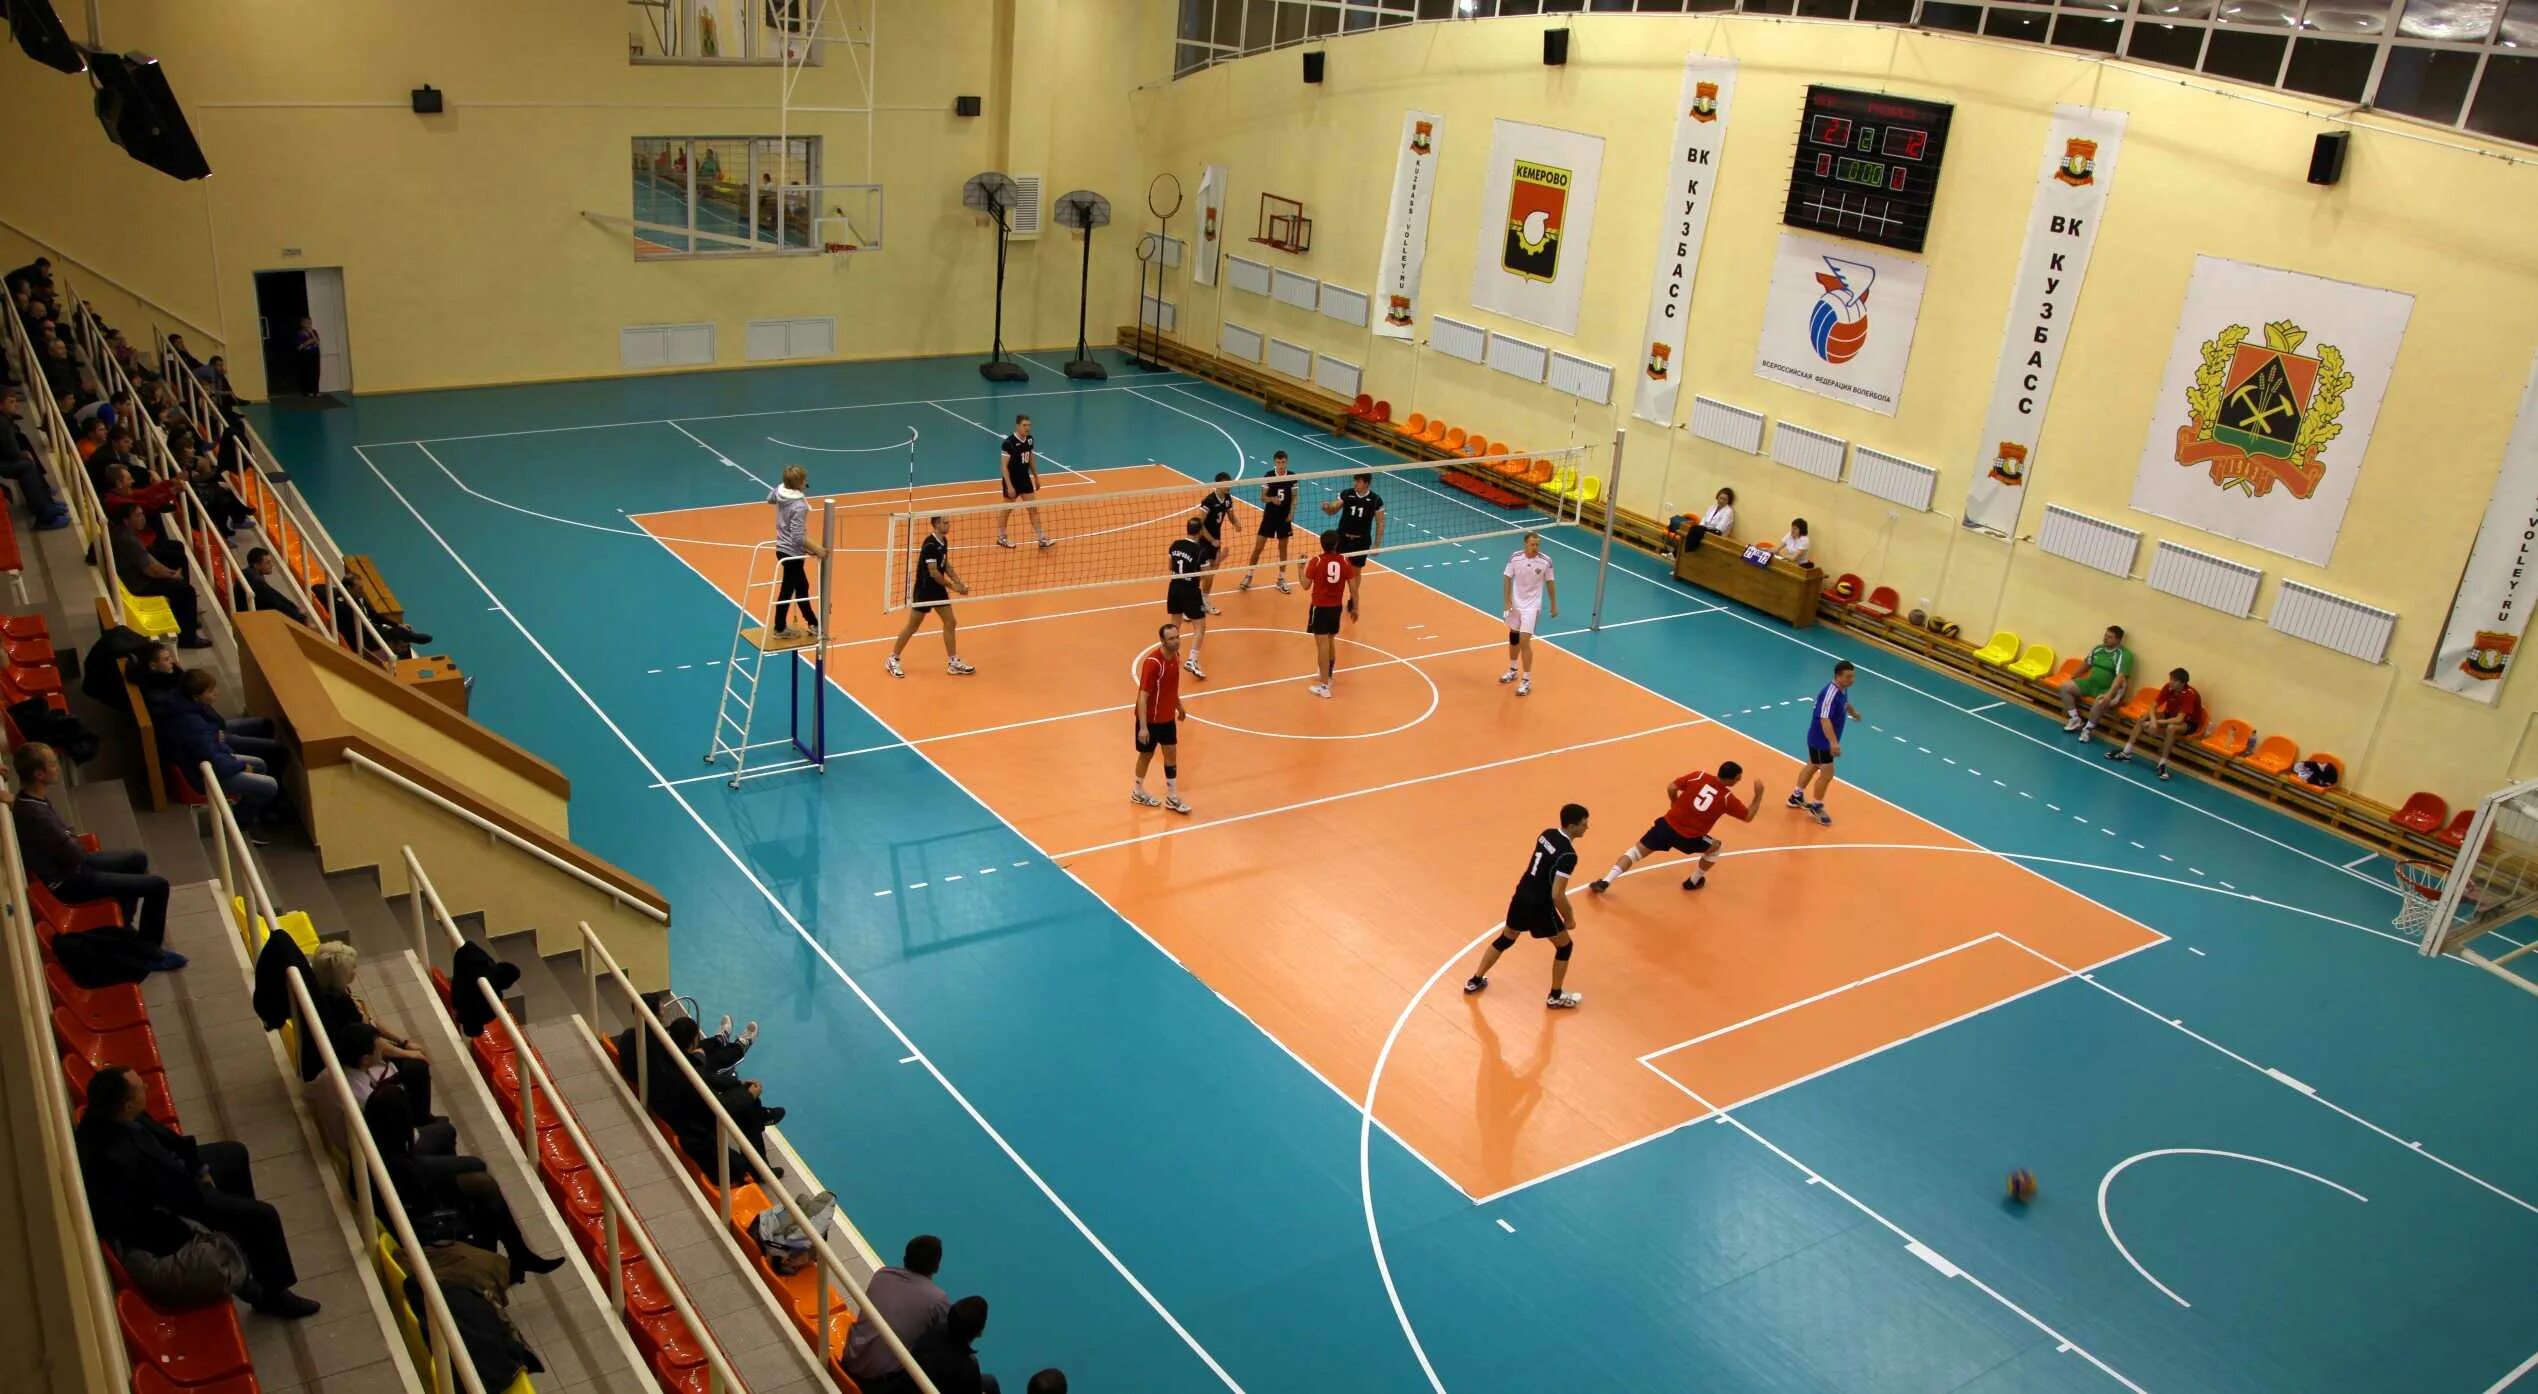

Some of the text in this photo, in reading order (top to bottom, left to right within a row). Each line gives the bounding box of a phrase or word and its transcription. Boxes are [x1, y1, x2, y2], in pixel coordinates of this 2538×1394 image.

[1687, 147, 1710, 165] ВК
[1516, 165, 1568, 186] КЕМЕРОВО
[2050, 215, 2083, 237] ВК
[1664, 178, 1699, 318] КУЗБАСС
[2018, 253, 2066, 415] КУЗБАСС
[1761, 360, 1891, 402] ВСЕРОССИЙСКАЯ ФЕДЕРАЦИЯ ВОЛЕЙБОЛА
[1277, 489, 1285, 501] 5
[1349, 505, 1364, 518] 11
[1326, 561, 1341, 584] 9
[2498, 500, 2538, 622] VOLLEY.RU
[1693, 783, 1719, 812] 5
[1530, 852, 1543, 876] 1
